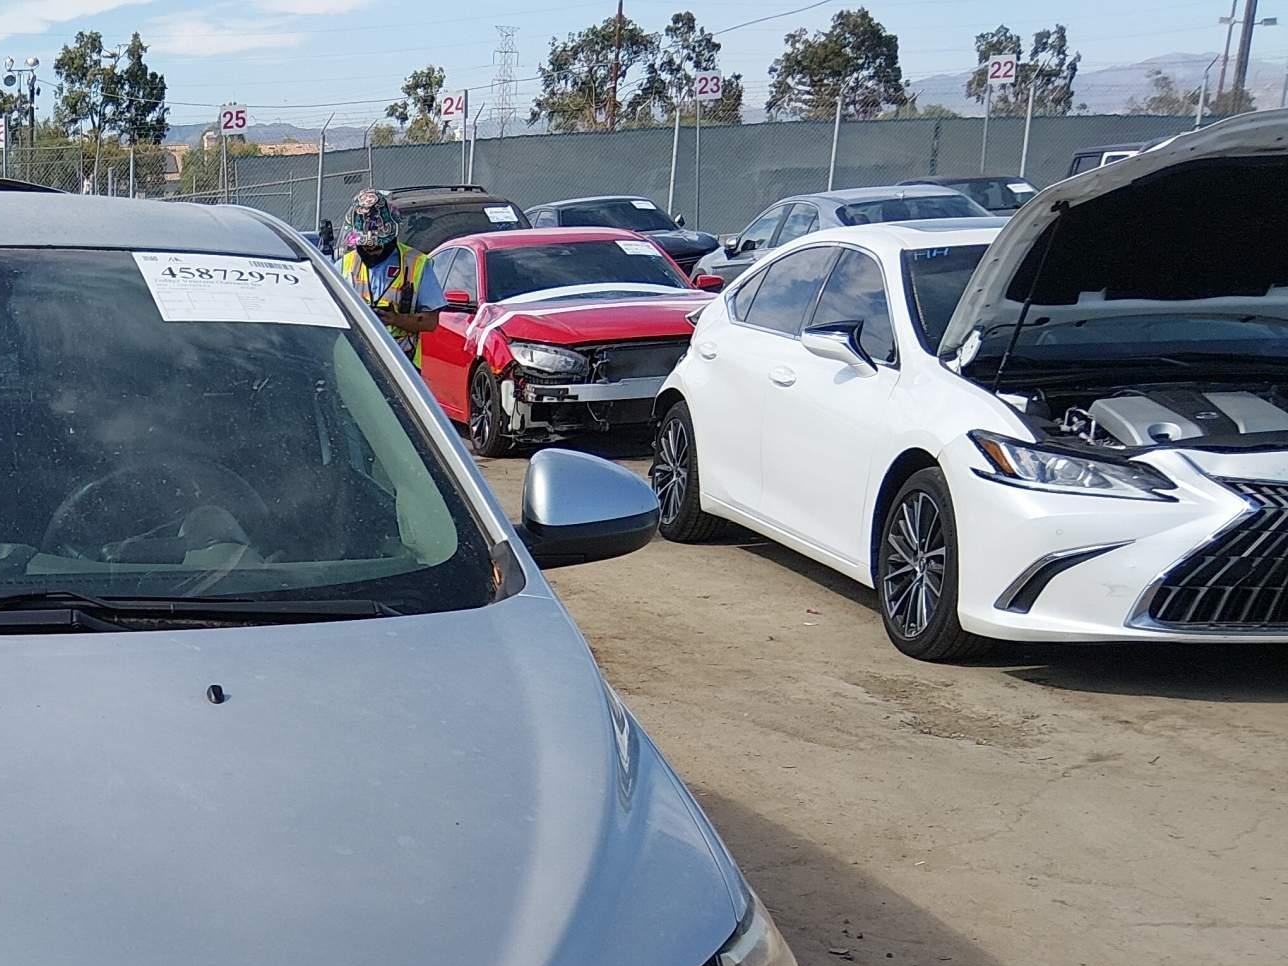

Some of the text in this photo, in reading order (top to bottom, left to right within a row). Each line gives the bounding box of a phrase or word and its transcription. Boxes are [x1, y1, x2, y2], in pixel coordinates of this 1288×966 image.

[990, 61, 1014, 79] 22
[698, 76, 720, 95] 23
[443, 96, 464, 115] 24
[222, 110, 246, 129] 25
[161, 266, 300, 286] 45872979
